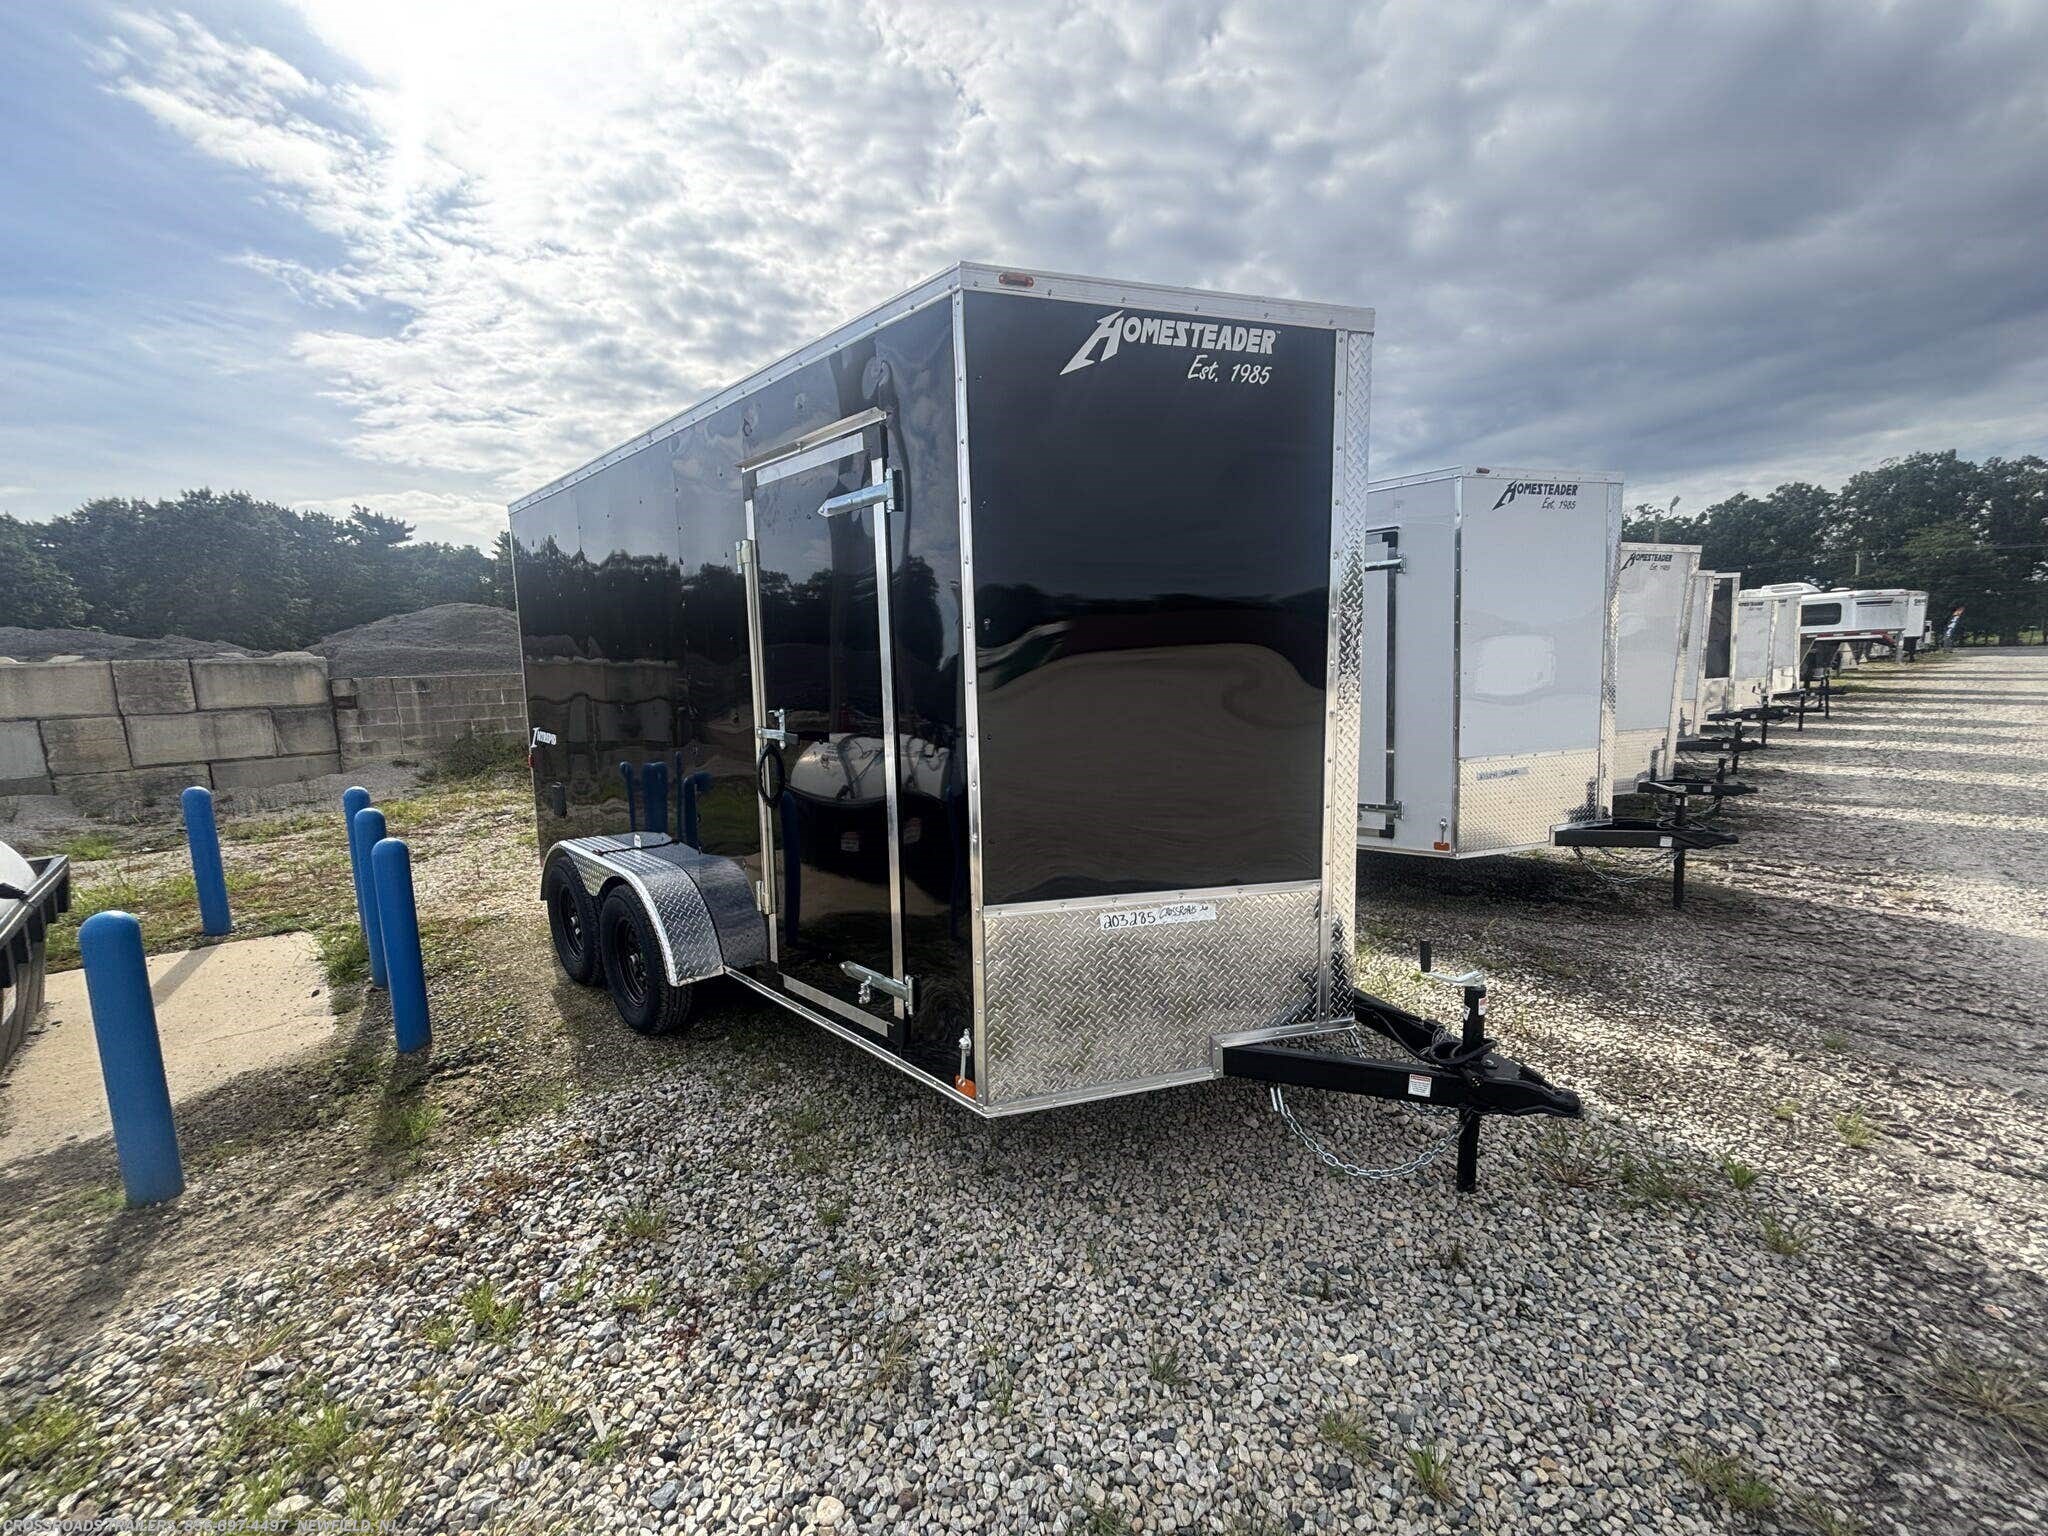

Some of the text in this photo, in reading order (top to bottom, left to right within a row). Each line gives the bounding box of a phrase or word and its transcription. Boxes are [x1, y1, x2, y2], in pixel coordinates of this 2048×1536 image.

[1187, 354, 1272, 384] Est. 1985
[1492, 480, 1578, 511] HOMESTEADER
[1103, 911, 1156, 929] 203285
